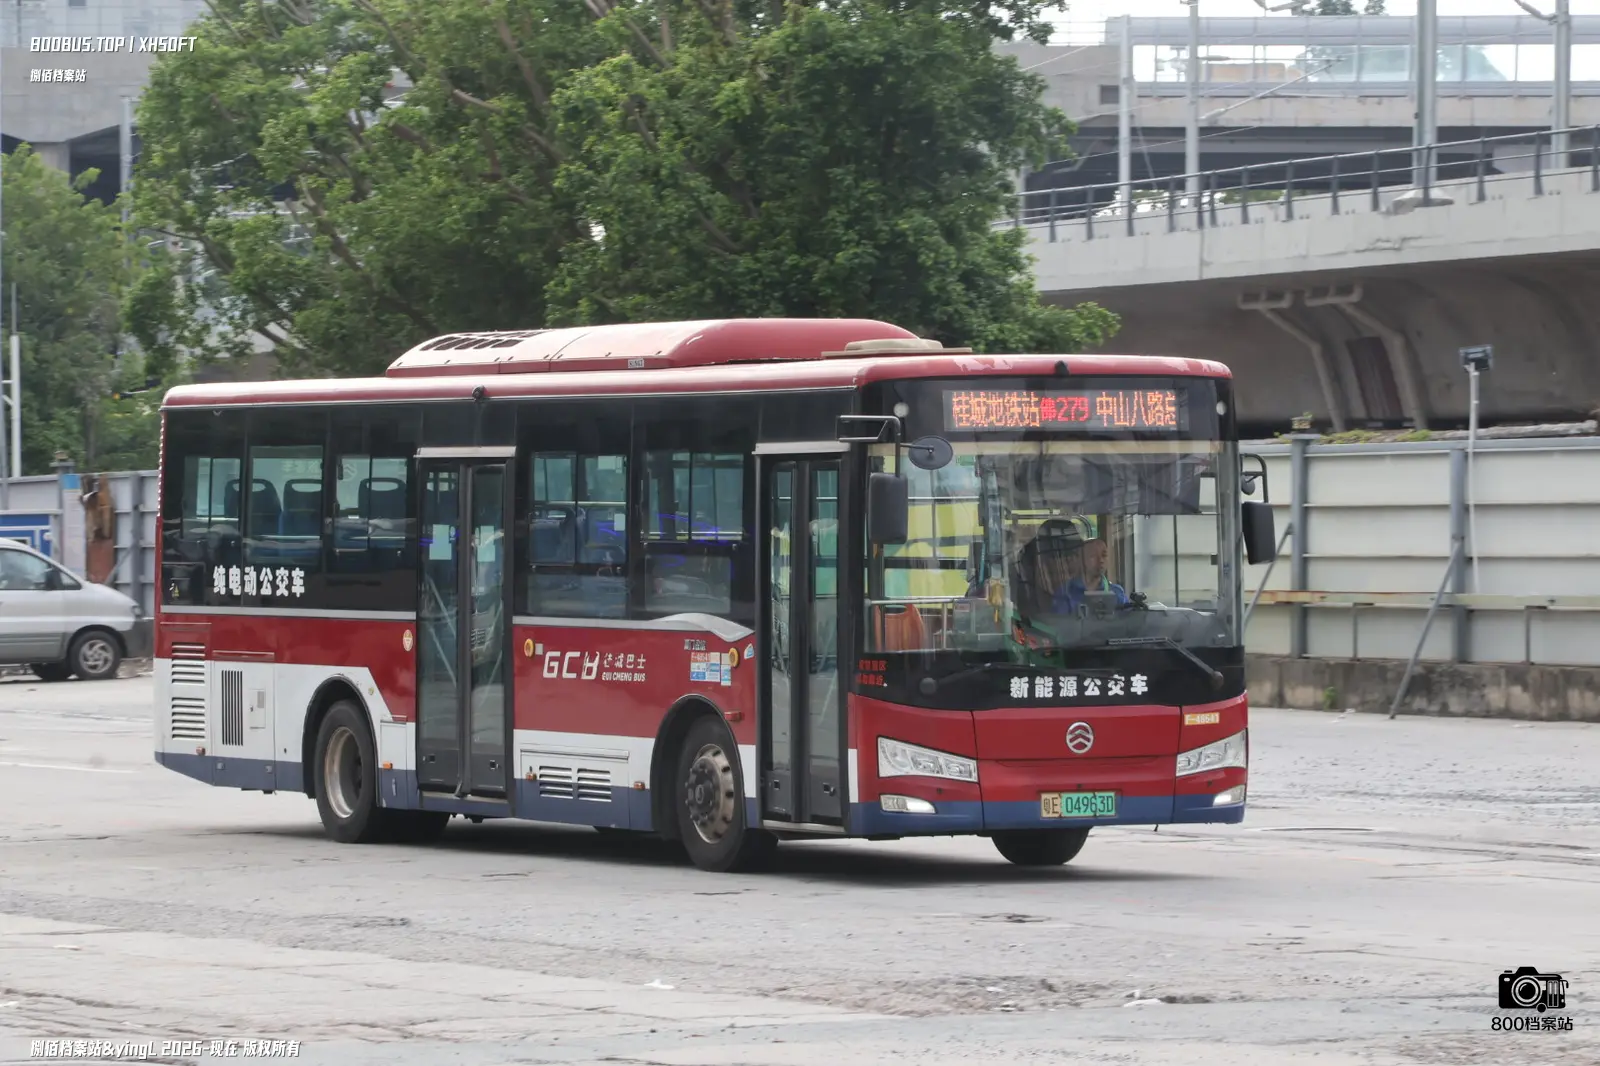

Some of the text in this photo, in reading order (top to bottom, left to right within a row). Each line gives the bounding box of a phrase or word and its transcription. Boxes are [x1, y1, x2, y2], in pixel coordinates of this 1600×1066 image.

[952, 391, 1041, 428] 桂城地铁站
[213, 564, 305, 598] 纯电动公交车
[613, 672, 632, 682] CHENG
[633, 672, 646, 682] BUS
[1010, 674, 1149, 698] 新能源公交车
[1065, 796, 1114, 814] 04963D
